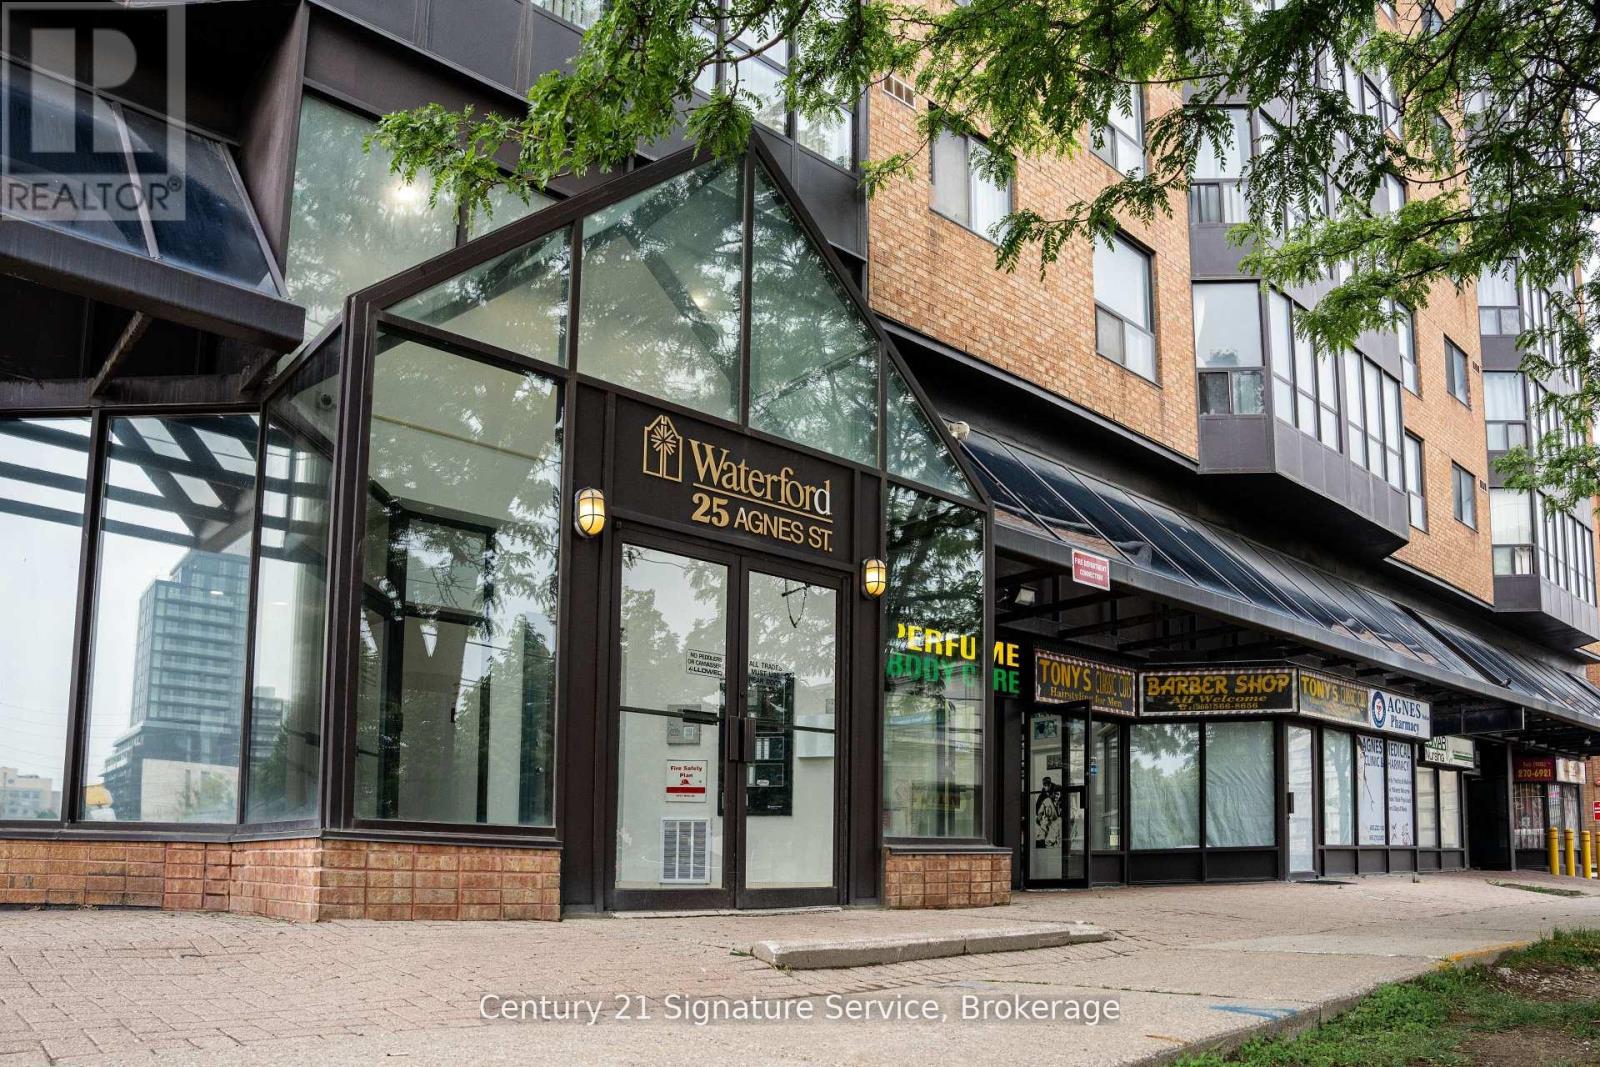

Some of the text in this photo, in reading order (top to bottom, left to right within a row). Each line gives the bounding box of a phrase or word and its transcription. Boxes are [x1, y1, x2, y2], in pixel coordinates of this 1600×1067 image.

[688, 438, 832, 516] Waterford
[691, 492, 833, 552] 25 AGNES ST.
[688, 666, 722, 676] ALLOWED
[962, 663, 1020, 694] CRE
[1146, 674, 1290, 696] BARBER SHOP
[1173, 695, 1267, 704] All Welcome
[1387, 696, 1421, 719] AGNES
[1390, 714, 1419, 735] Pharmacy
